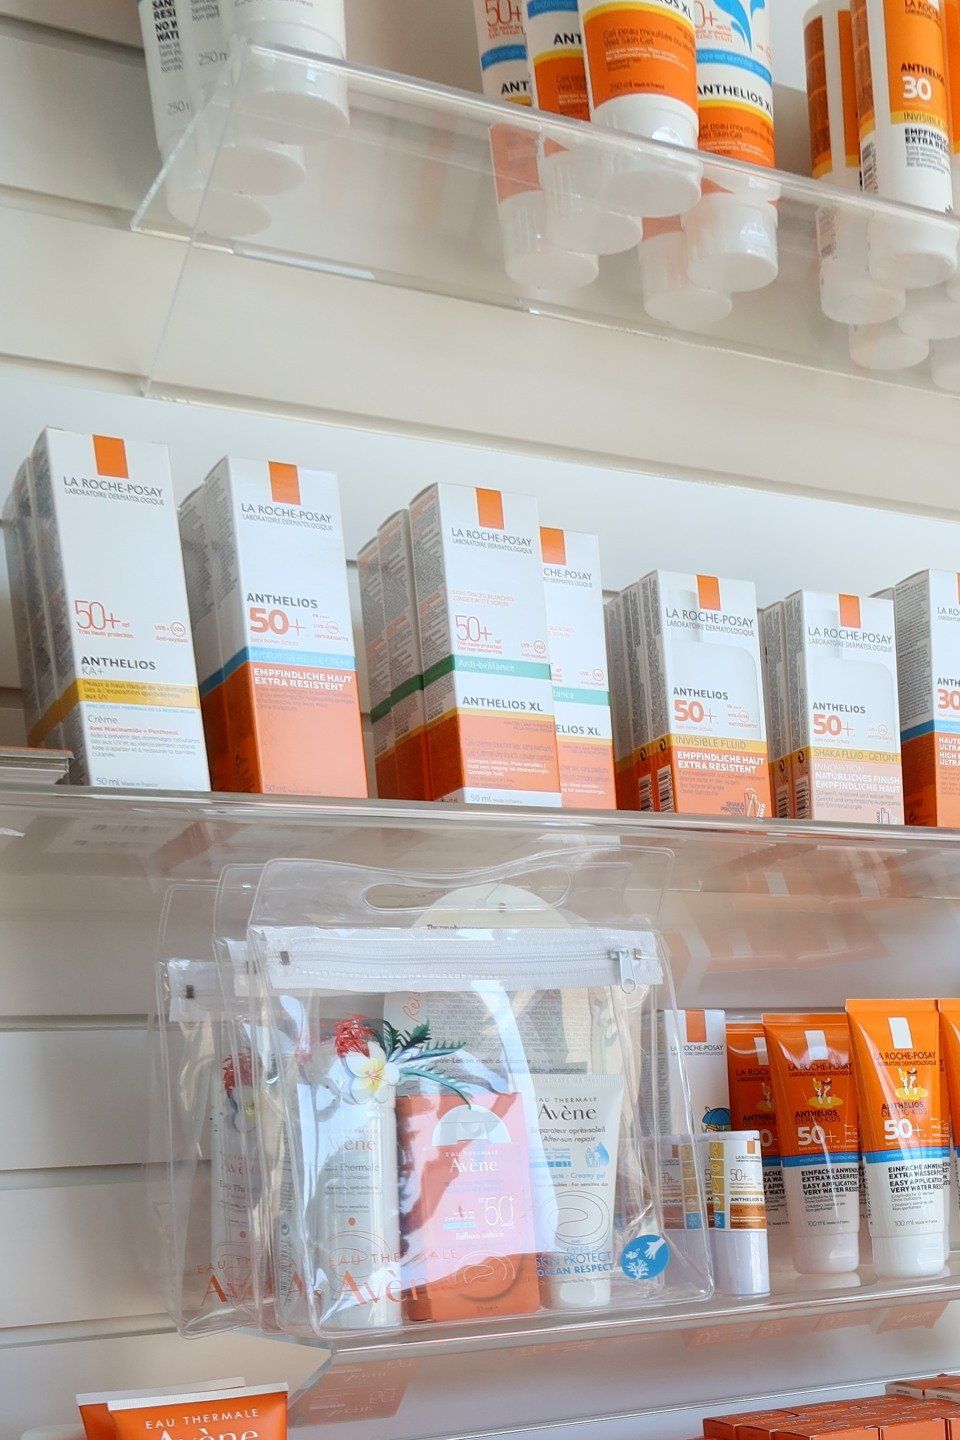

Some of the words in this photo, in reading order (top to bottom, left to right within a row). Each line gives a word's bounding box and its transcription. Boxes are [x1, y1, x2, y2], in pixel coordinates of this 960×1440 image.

[902, 75, 932, 101] 30
[63, 476, 79, 489] LA
[81, 478, 164, 498] ROCHE-POSAY
[241, 503, 257, 514] LA
[260, 505, 332, 524] ROCHE-POSAY
[246, 592, 318, 609] ANTHELIOS
[74, 599, 121, 631] 50+
[250, 607, 306, 636] 50+
[665, 608, 684, 623] LA
[683, 611, 754, 629] ROCHE-POSAY
[81, 656, 156, 671] ANTHELIOS
[458, 659, 515, 673] Anti-brillance
[254, 668, 325, 682] EMPFINDLICHE
[327, 674, 352, 684] HAUT
[254, 676, 289, 688] EXTRA
[290, 679, 344, 691] RESISTENT
[673, 687, 729, 701] ANTHELIOS
[462, 696, 527, 711] ANTHELIOS
[529, 700, 544, 712] XL
[812, 701, 867, 716] ANTHELIOS
[674, 734, 722, 749] INVISIBLE
[725, 738, 747, 751] FLUID
[677, 750, 738, 765] EMPFINDLICHE
[741, 755, 765, 766] HAUT
[538, 1104, 597, 1121] Avène
[911, 1184, 931, 1192] WATER
[145, 1417, 177, 1431] EAU
[182, 1408, 260, 1426] THERMALE
